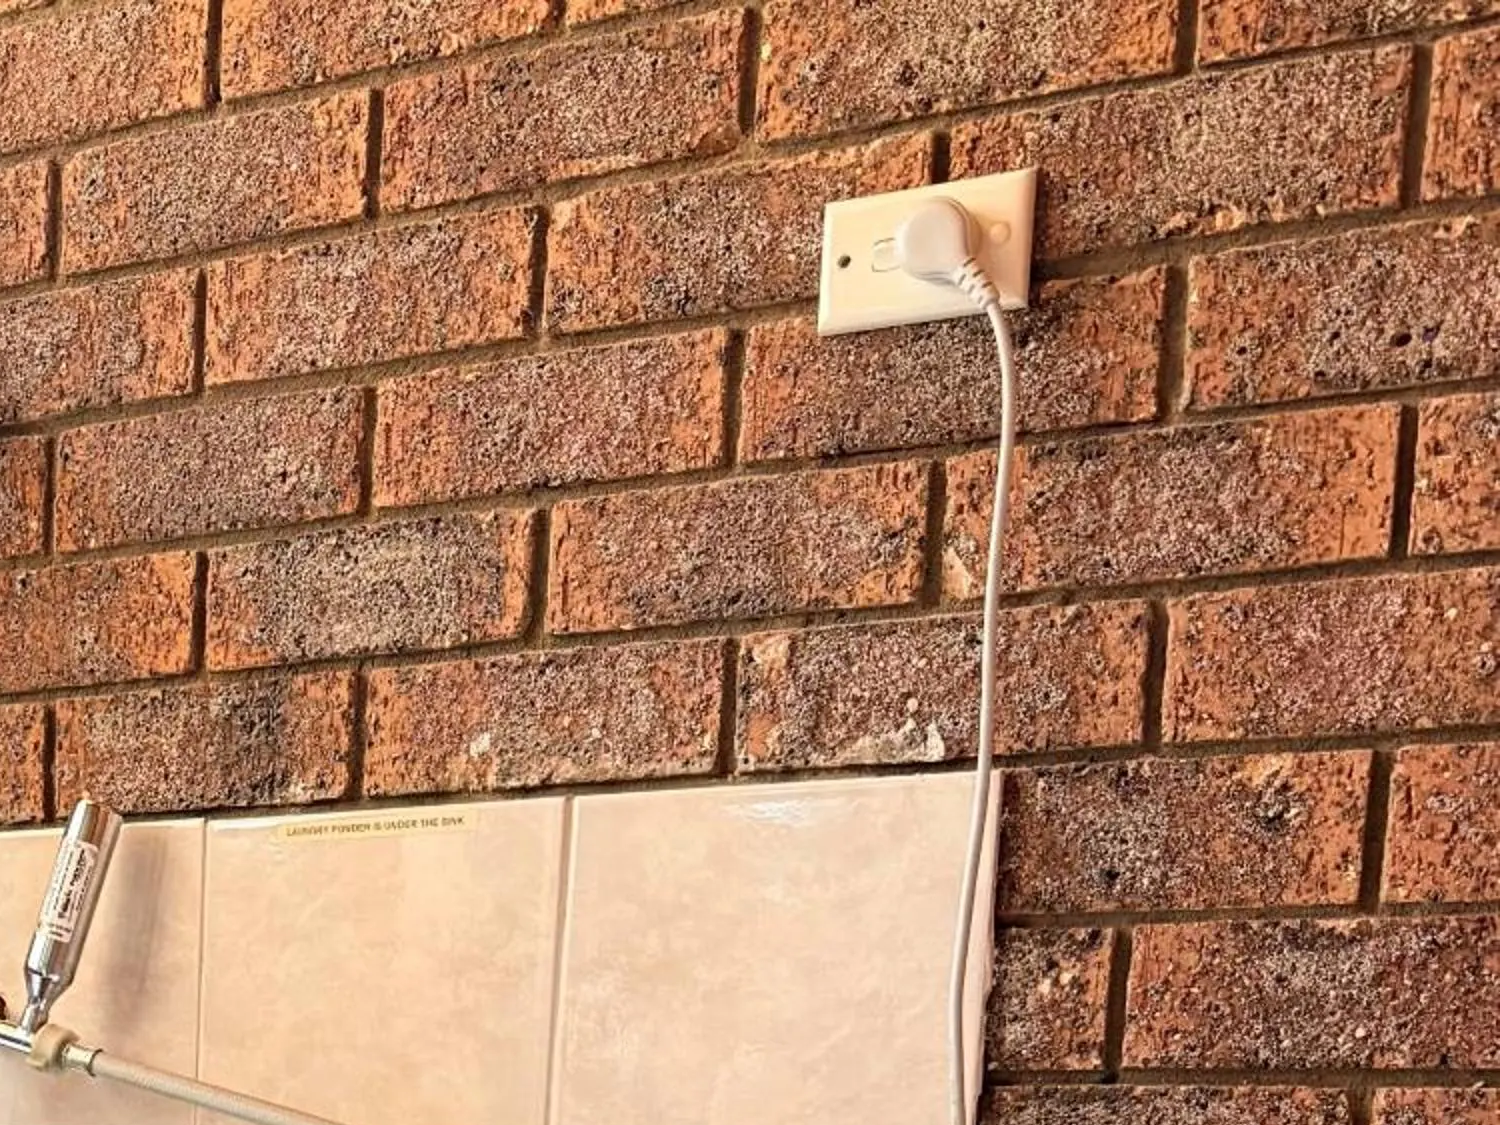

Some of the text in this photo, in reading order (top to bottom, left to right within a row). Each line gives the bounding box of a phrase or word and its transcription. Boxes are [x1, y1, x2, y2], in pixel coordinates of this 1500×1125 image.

[331, 823, 371, 833] POWDER
[384, 819, 418, 831] UNDER
[420, 817, 439, 829] THE
